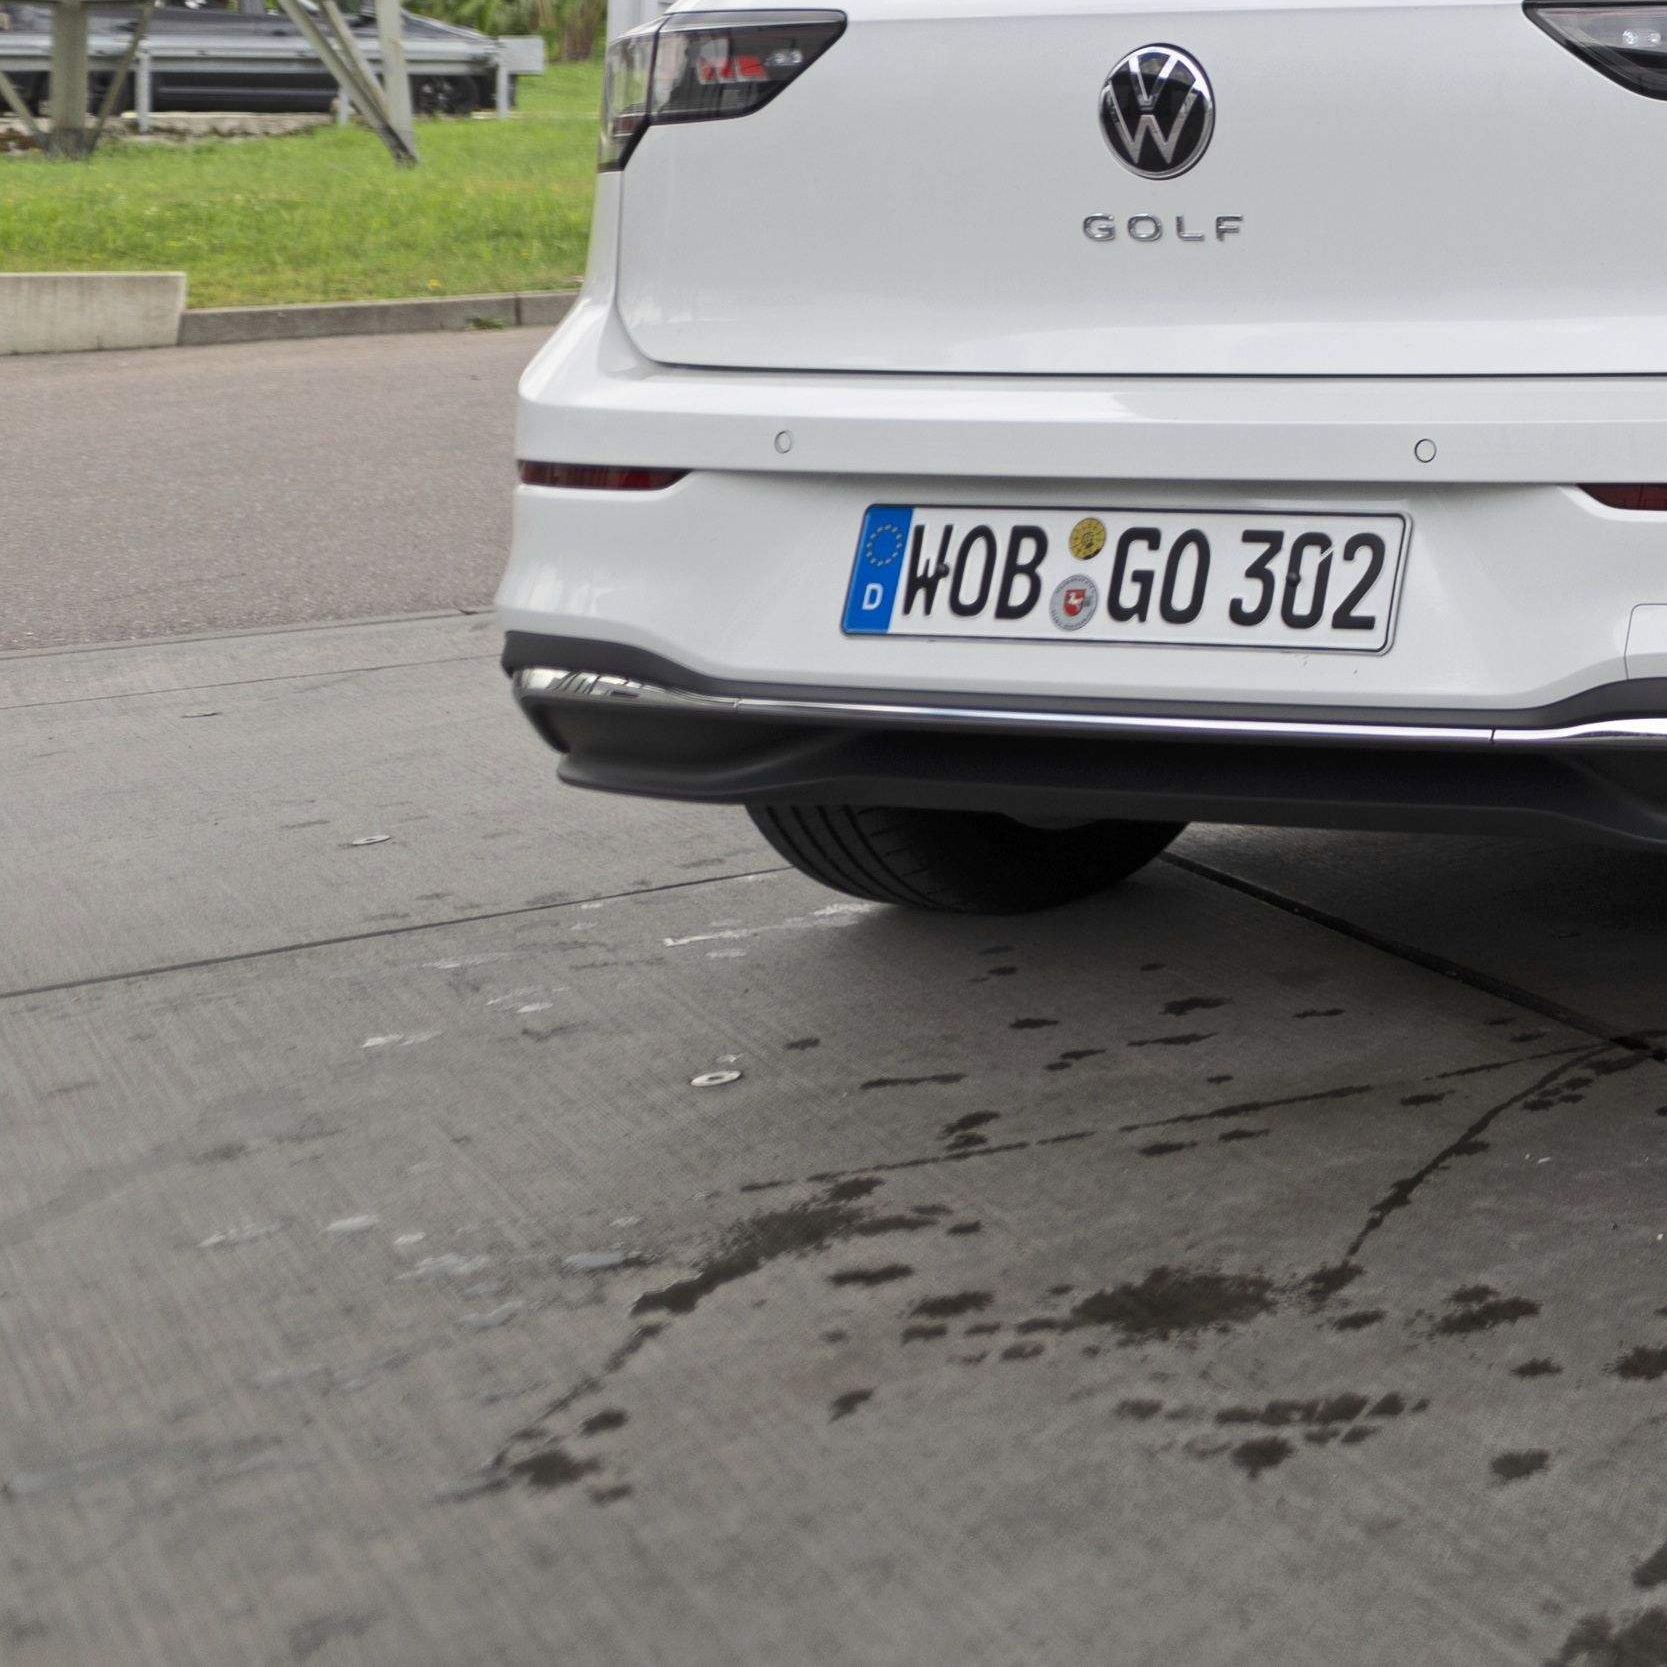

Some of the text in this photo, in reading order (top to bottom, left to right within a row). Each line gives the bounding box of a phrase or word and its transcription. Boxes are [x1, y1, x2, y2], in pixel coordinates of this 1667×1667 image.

[1082, 213, 1244, 243] GOLF
[902, 523, 1049, 621] WOB
[1106, 526, 1211, 625] GO
[1228, 528, 1387, 631] 302
[861, 582, 883, 611] D
